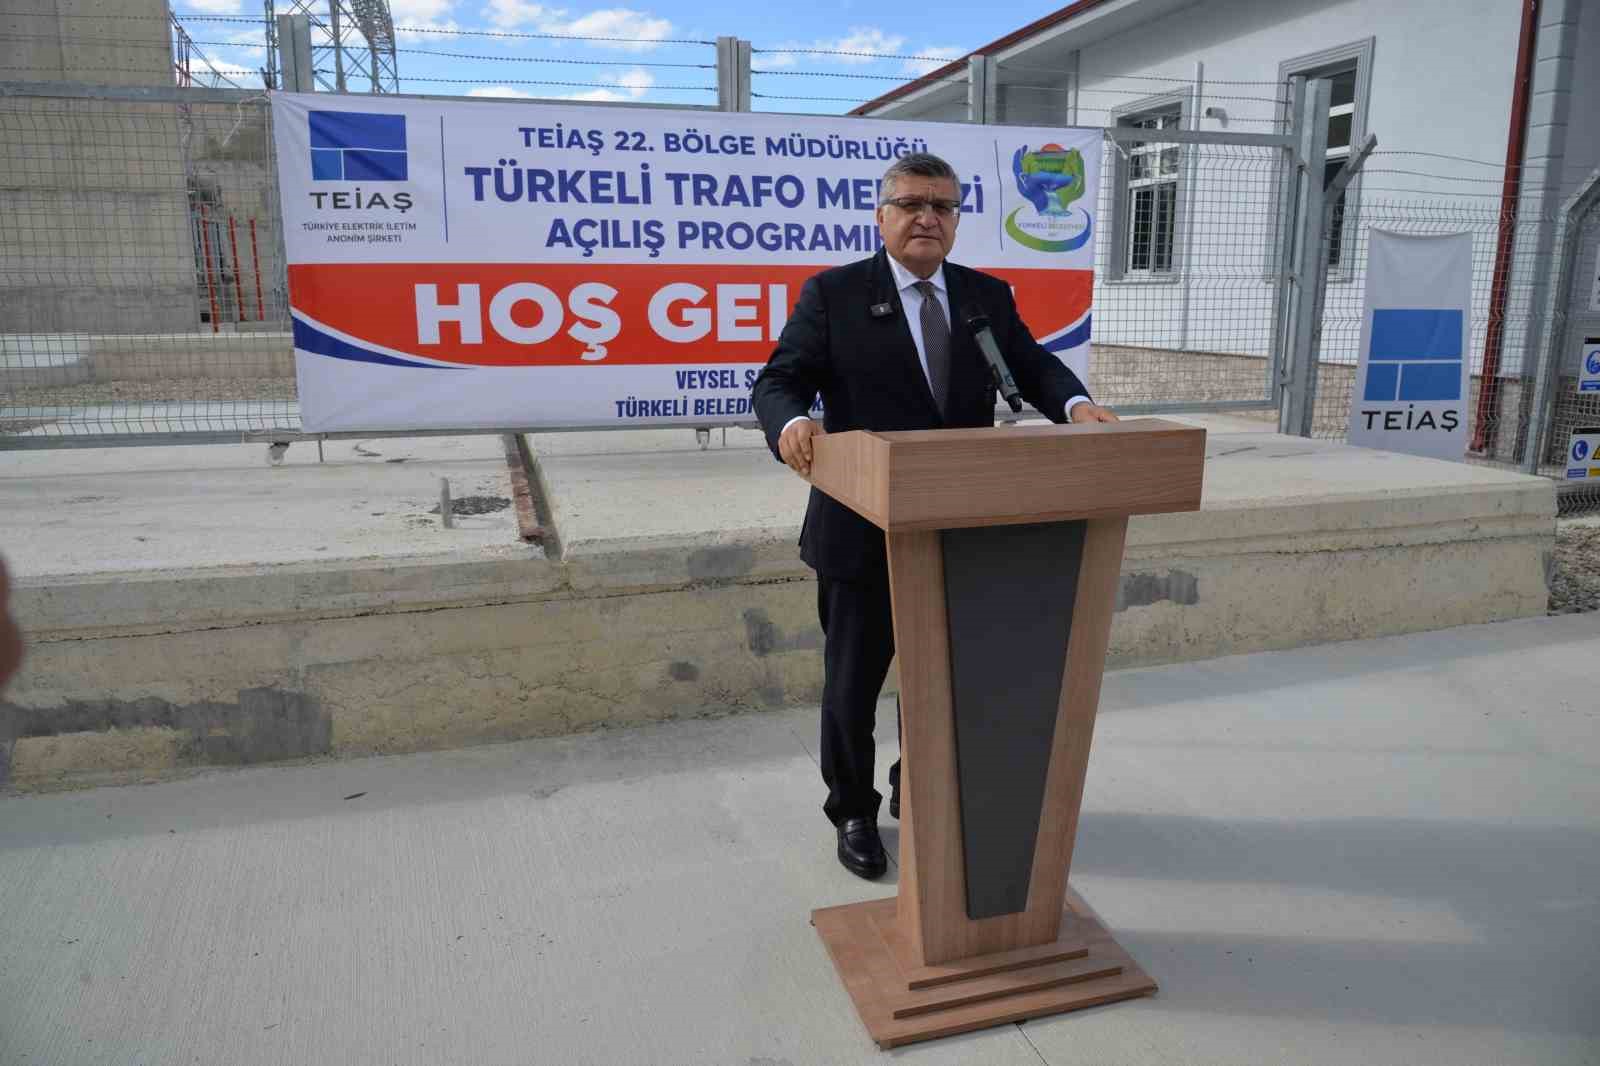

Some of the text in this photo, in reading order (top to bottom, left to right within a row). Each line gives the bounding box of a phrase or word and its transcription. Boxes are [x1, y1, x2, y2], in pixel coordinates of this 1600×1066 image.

[518, 123, 605, 156] TEİAŞ
[613, 131, 655, 152] 22.
[663, 129, 755, 156] BÖLGE
[463, 158, 652, 206] TÜRKELİ
[664, 172, 805, 209] TRAFO
[308, 187, 414, 214] TEİAŞ
[545, 218, 666, 258] AÇILIŞ
[414, 281, 622, 361] HOŞ
[675, 369, 740, 390] VEYSEL
[615, 395, 688, 419] TÜRKELİ
[1361, 403, 1460, 433] TEİAŞ
